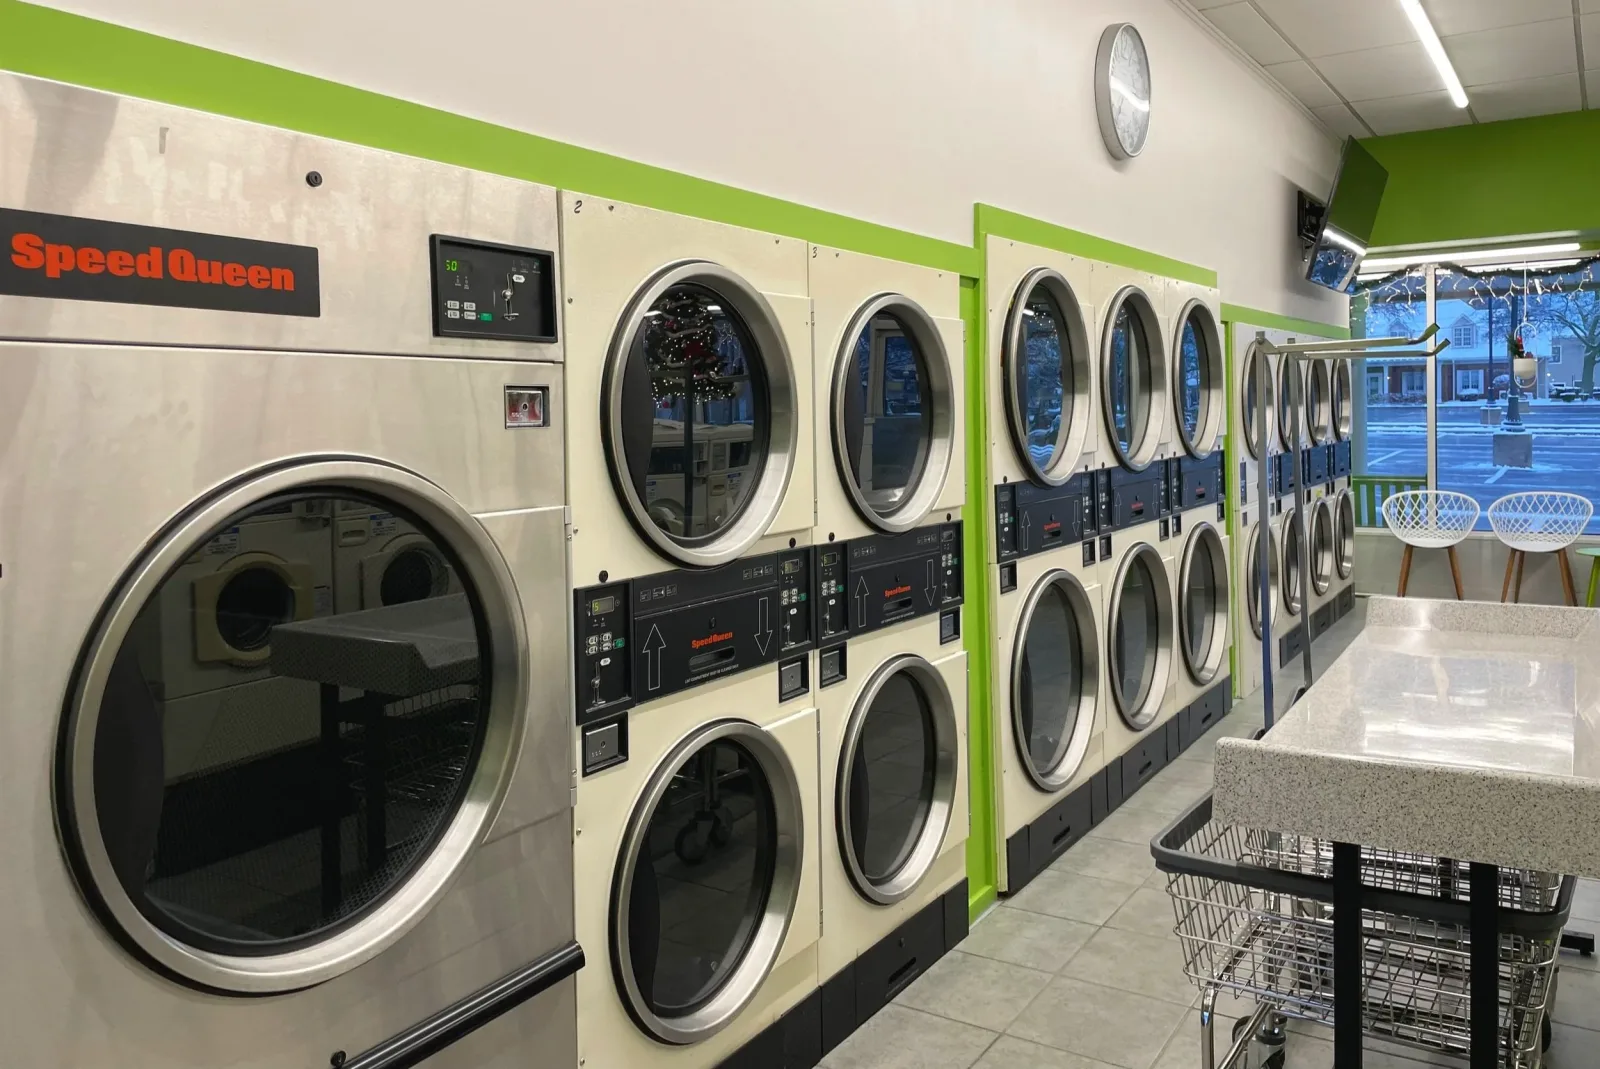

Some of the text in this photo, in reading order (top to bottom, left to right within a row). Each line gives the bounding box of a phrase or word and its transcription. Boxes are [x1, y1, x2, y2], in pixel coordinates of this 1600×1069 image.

[574, 200, 583, 214] 2
[11, 233, 295, 291] Speed Queen
[692, 632, 733, 649] Speed Queen
